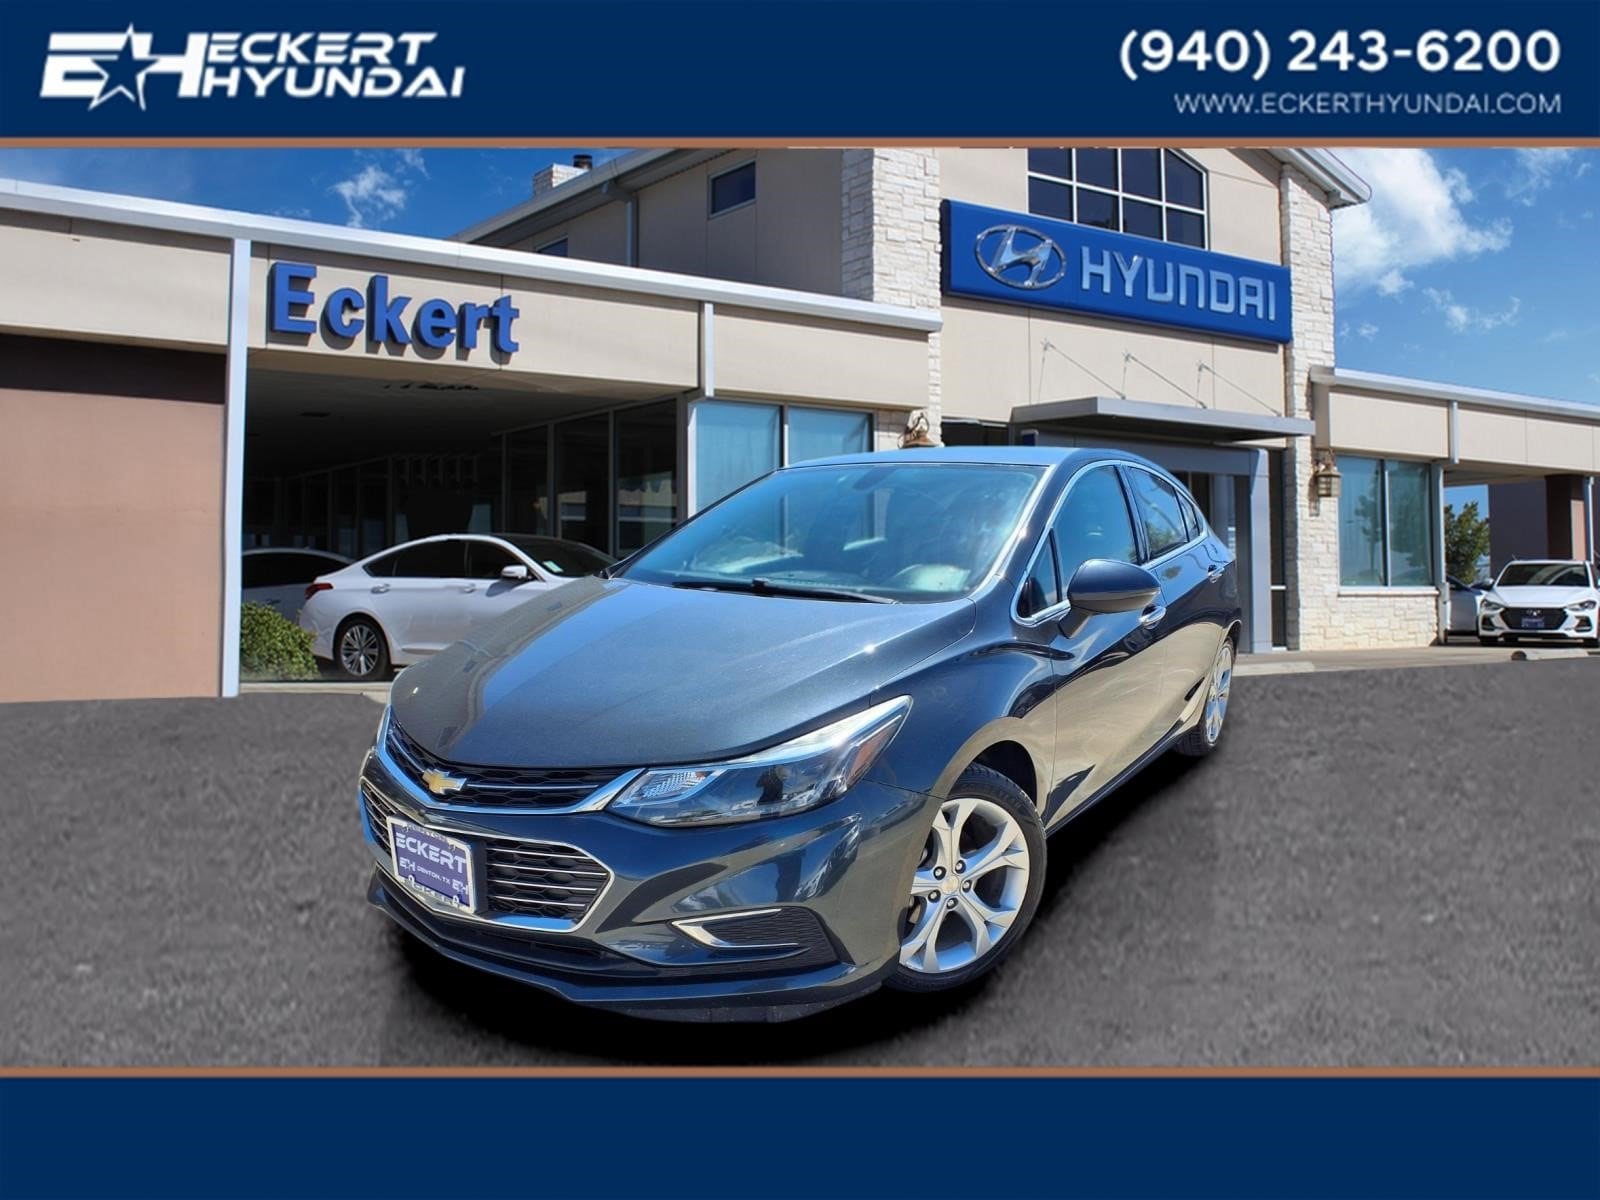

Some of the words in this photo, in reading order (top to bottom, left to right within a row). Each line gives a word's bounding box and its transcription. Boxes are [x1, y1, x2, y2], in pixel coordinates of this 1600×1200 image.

[271, 261, 519, 353] Eckert
[1081, 246, 1277, 322] HYUNDAI
[395, 831, 466, 874] ECKERT
